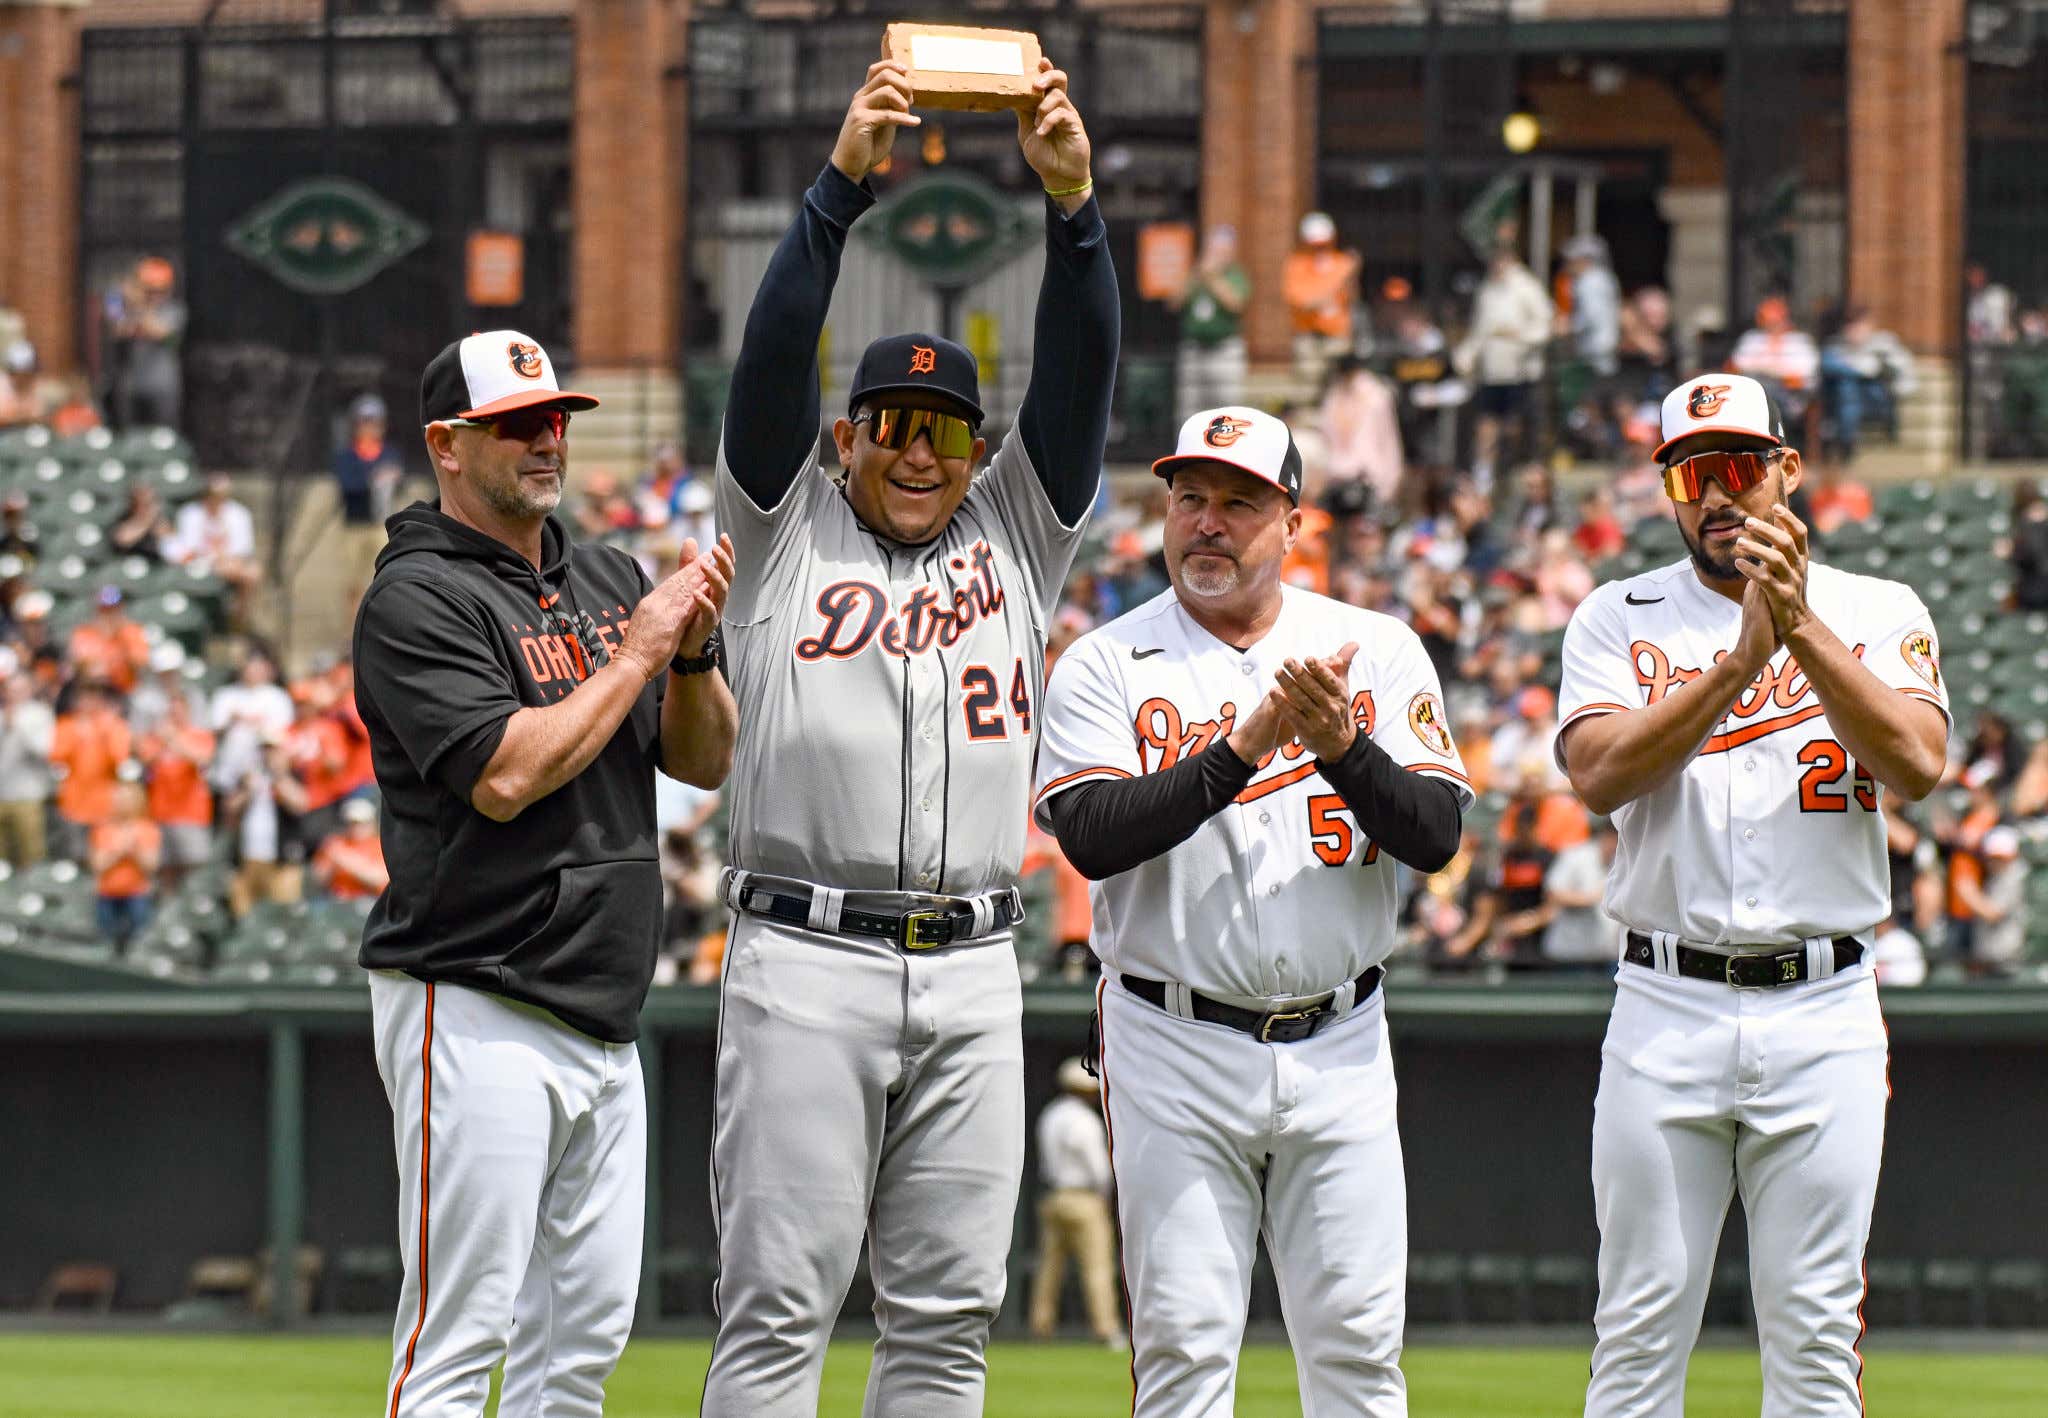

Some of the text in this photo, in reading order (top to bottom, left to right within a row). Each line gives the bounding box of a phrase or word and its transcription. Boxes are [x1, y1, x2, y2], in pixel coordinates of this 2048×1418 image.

[909, 345, 936, 375] D
[794, 540, 1005, 660] Detroit
[960, 657, 1031, 741] 24
[1308, 794, 1380, 867] 5
[1782, 962, 1797, 981] 25
